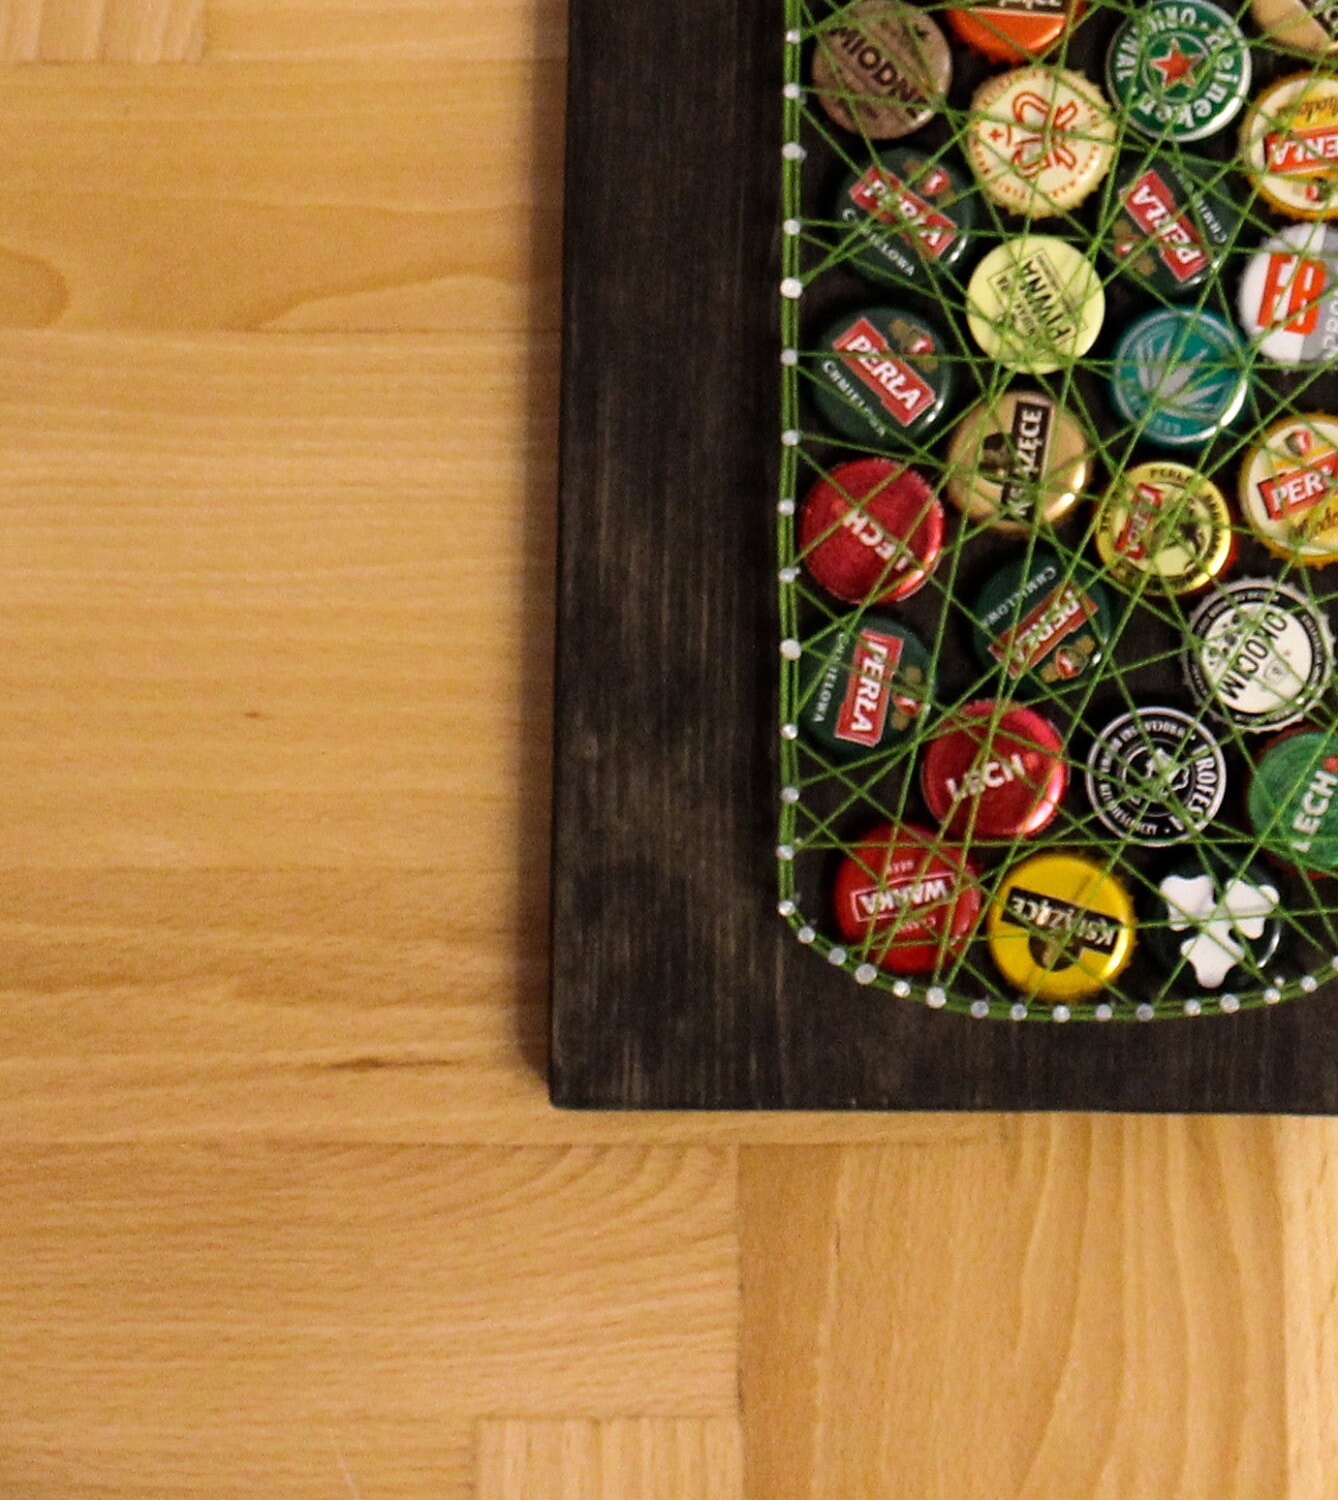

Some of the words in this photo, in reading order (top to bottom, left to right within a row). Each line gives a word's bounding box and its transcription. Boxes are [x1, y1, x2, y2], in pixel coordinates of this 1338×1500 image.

[1115, 5, 1198, 83] ORIGNAL
[1131, 182, 1202, 264] PERŁA
[845, 333, 921, 410] PERŁA
[840, 506, 913, 572] LECH
[849, 640, 887, 729] PERŁA
[1216, 608, 1289, 701] OKOCIM
[944, 751, 1025, 802] LECH
[1168, 743, 1217, 832] PROFESA
[858, 877, 948, 914] WARKA
